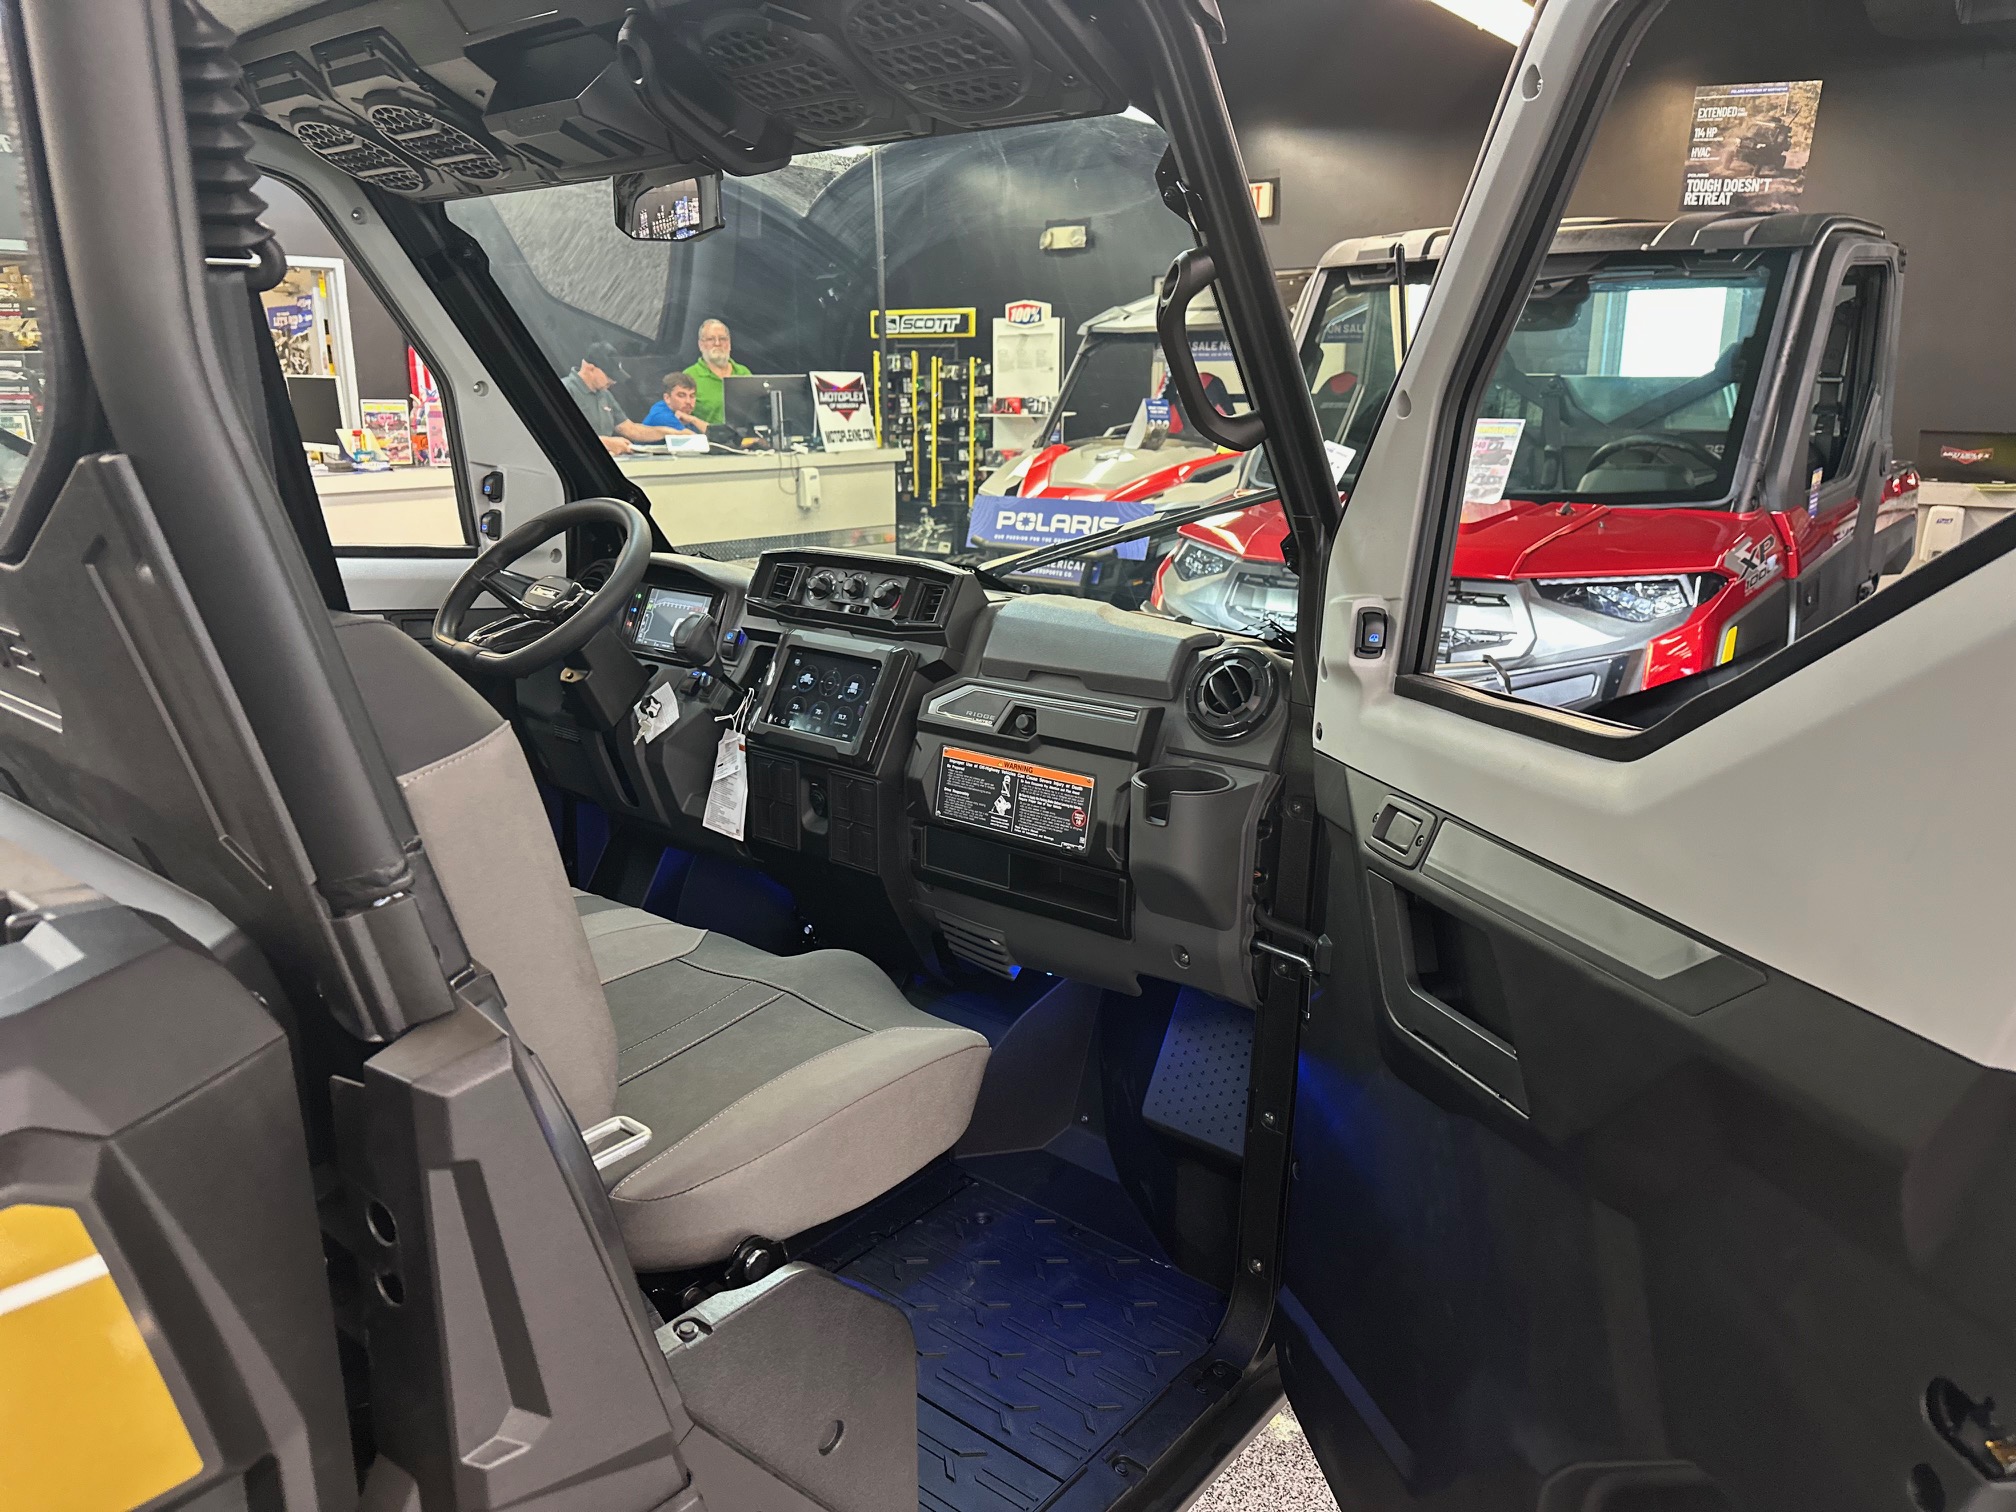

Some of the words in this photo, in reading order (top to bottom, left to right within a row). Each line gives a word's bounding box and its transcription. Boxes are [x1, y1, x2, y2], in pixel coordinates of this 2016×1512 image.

[1697, 106, 1738, 118] EXTENDED
[1694, 127, 1705, 138] 114
[1706, 127, 1718, 138] HP
[1690, 147, 1711, 158] HVAC
[1686, 179, 1722, 192] TOUGH
[1723, 178, 1773, 192] DOESN'T
[1683, 192, 1734, 206] RETREAT
[1010, 307, 1040, 322] 100%
[902, 317, 958, 330] SCOTT
[1191, 341, 1219, 351] SALE
[819, 391, 864, 402] MOTOPLEX
[995, 510, 1121, 536] POLARIS
[1739, 535, 1775, 580] XP
[965, 710, 996, 721] RIDGE
[1003, 761, 1034, 774] WARNING
